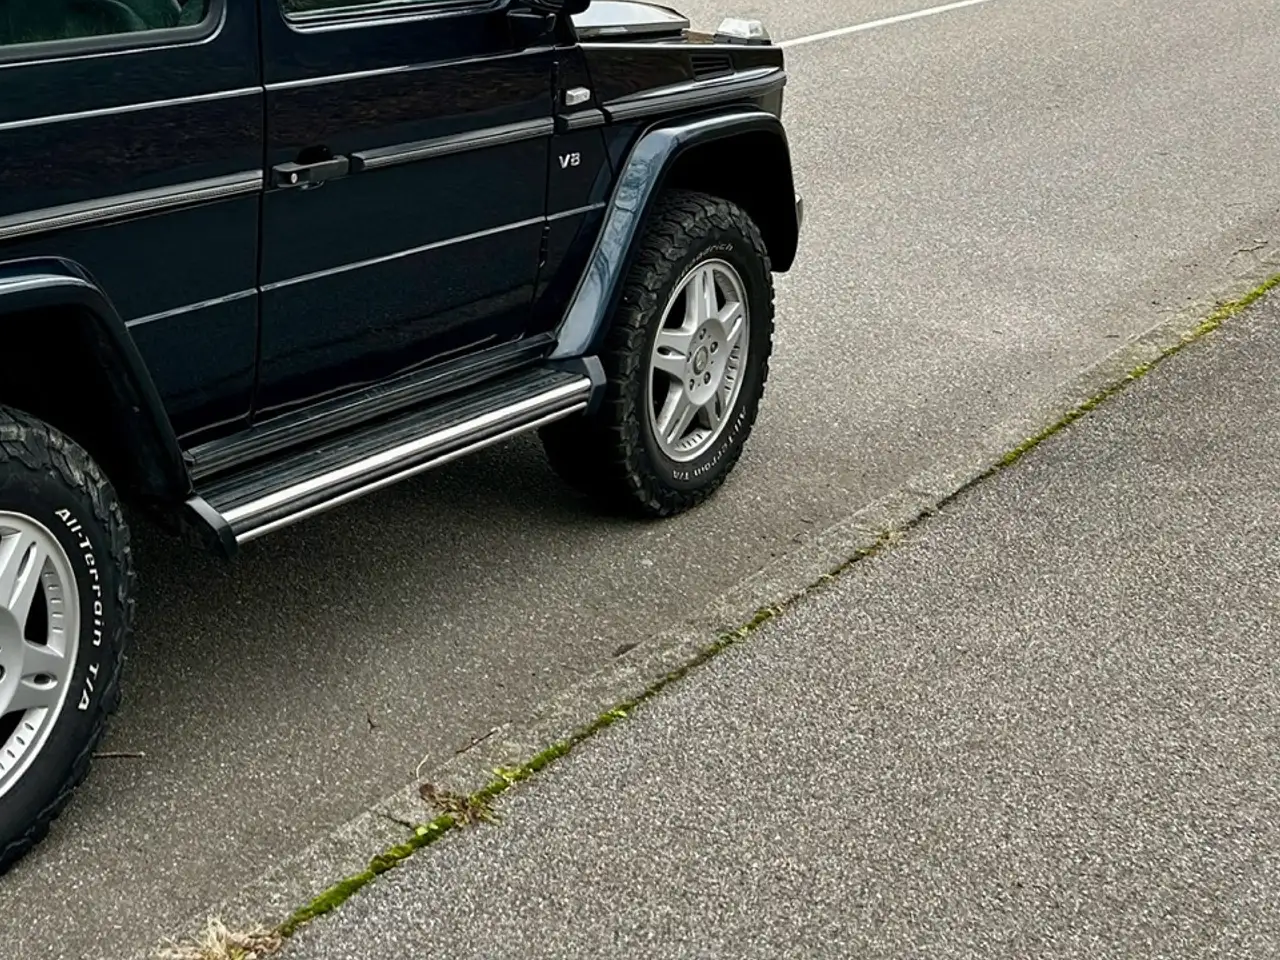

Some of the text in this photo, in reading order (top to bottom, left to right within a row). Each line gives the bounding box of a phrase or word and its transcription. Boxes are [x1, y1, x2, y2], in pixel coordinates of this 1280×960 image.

[558, 151, 580, 169] V8
[55, 507, 105, 711] All-Terrain T/A
